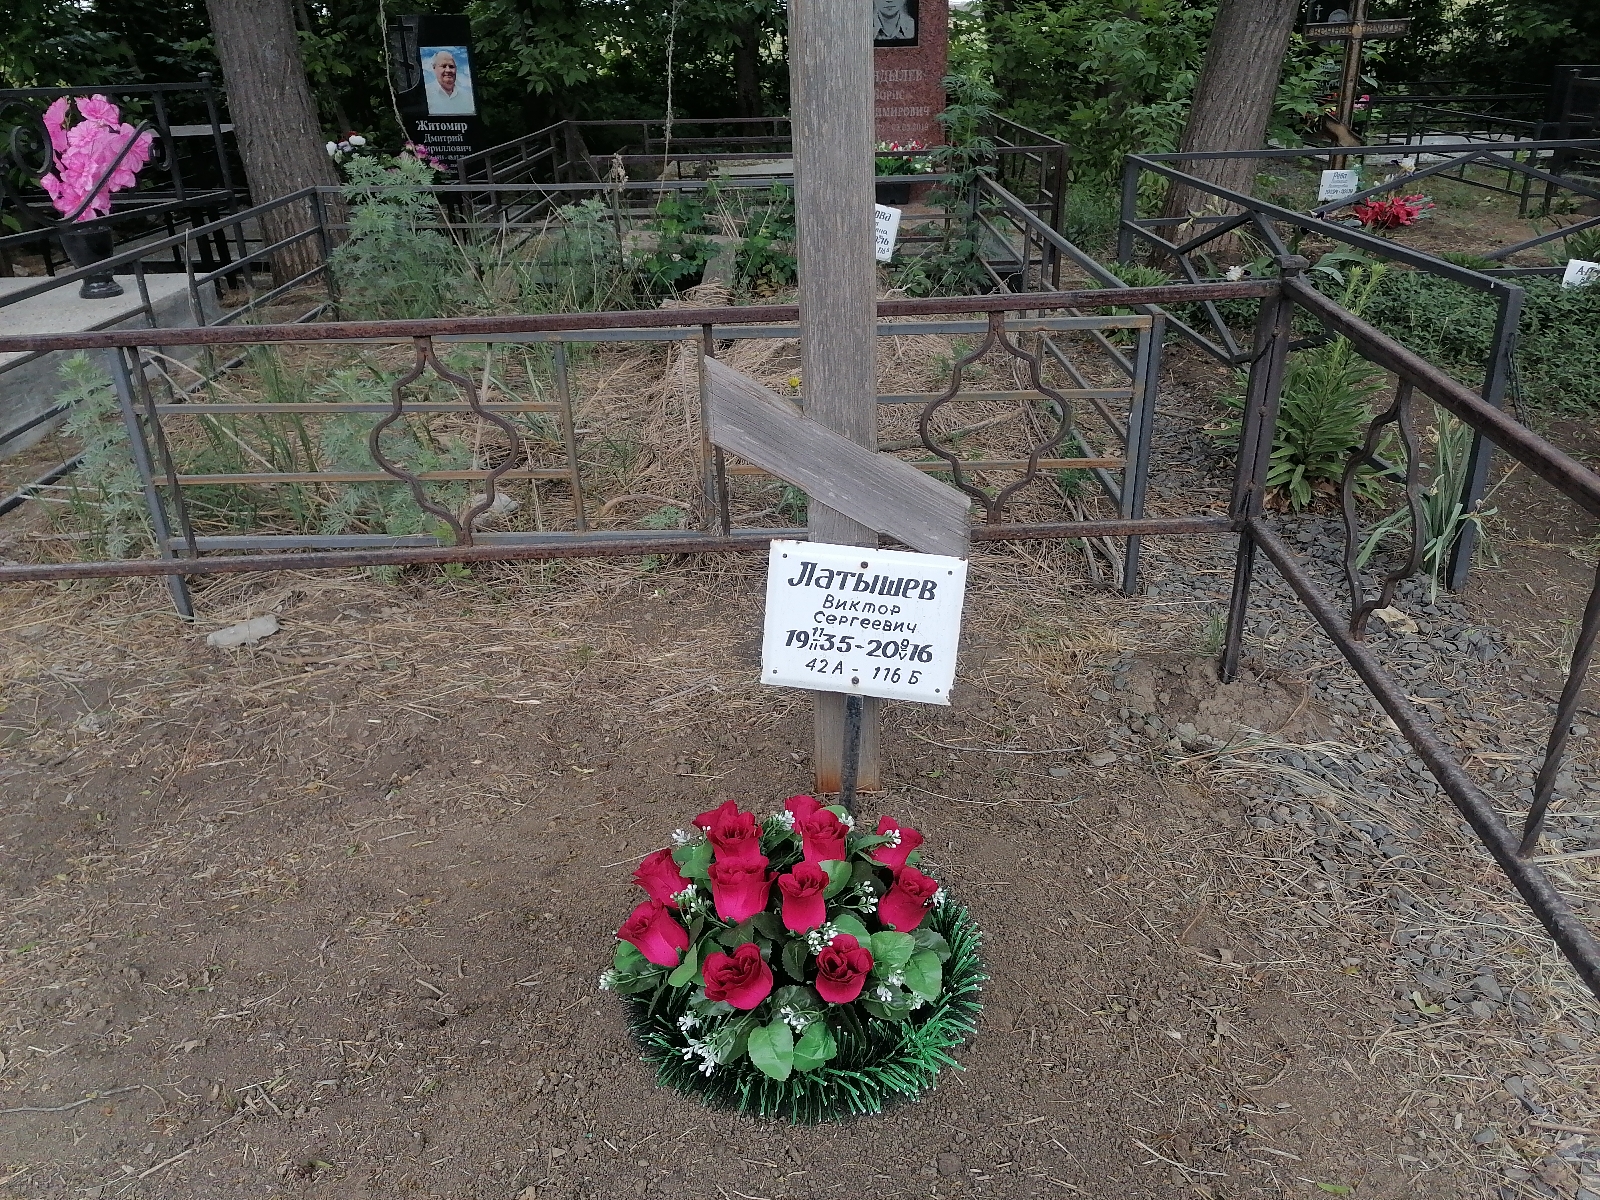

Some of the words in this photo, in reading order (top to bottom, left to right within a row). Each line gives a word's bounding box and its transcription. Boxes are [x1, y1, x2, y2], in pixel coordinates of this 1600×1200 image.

[415, 120, 468, 133] Житомир
[424, 133, 464, 144] Дмитрий
[425, 145, 472, 154] ириллович
[787, 561, 938, 600] Латышев
[822, 594, 901, 615] Виктор
[813, 610, 918, 633] Сергеевич
